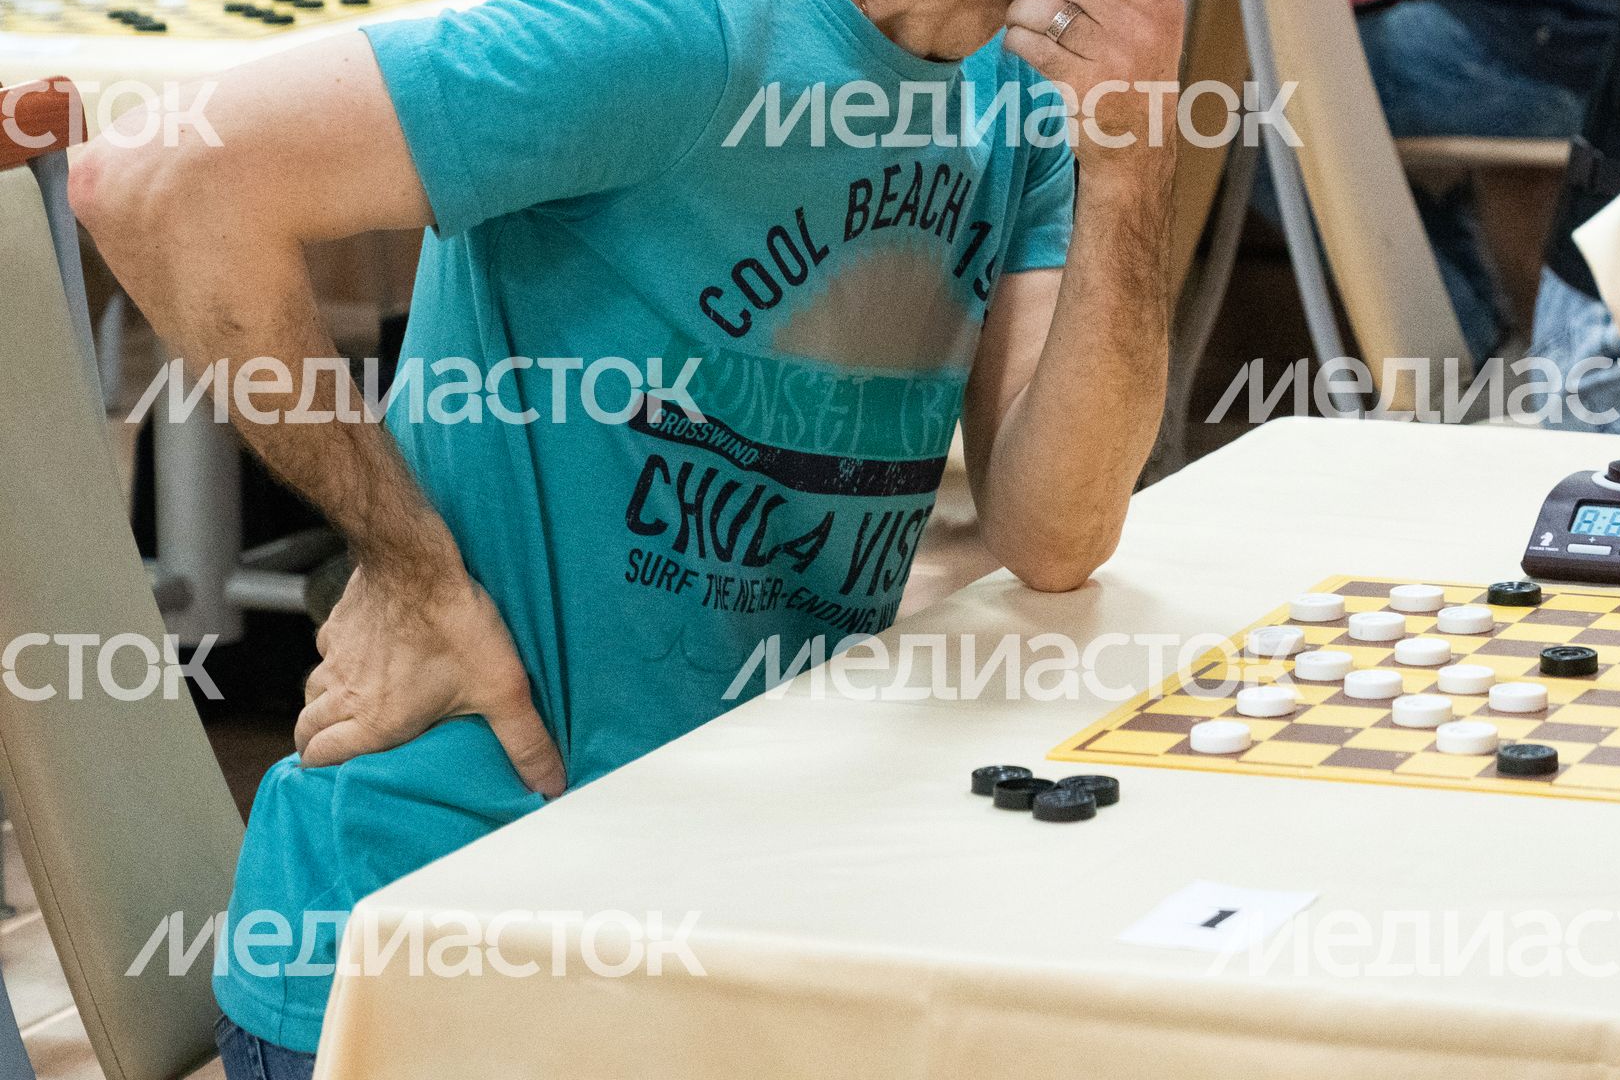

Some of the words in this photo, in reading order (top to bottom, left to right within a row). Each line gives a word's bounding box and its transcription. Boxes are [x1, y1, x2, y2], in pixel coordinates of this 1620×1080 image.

[698, 205, 831, 338] COOL
[842, 160, 972, 244] BEACH
[648, 407, 760, 467] CROSSWIND
[624, 453, 835, 573] CHULA
[623, 547, 700, 595] SURF
[701, 573, 735, 611] THE
